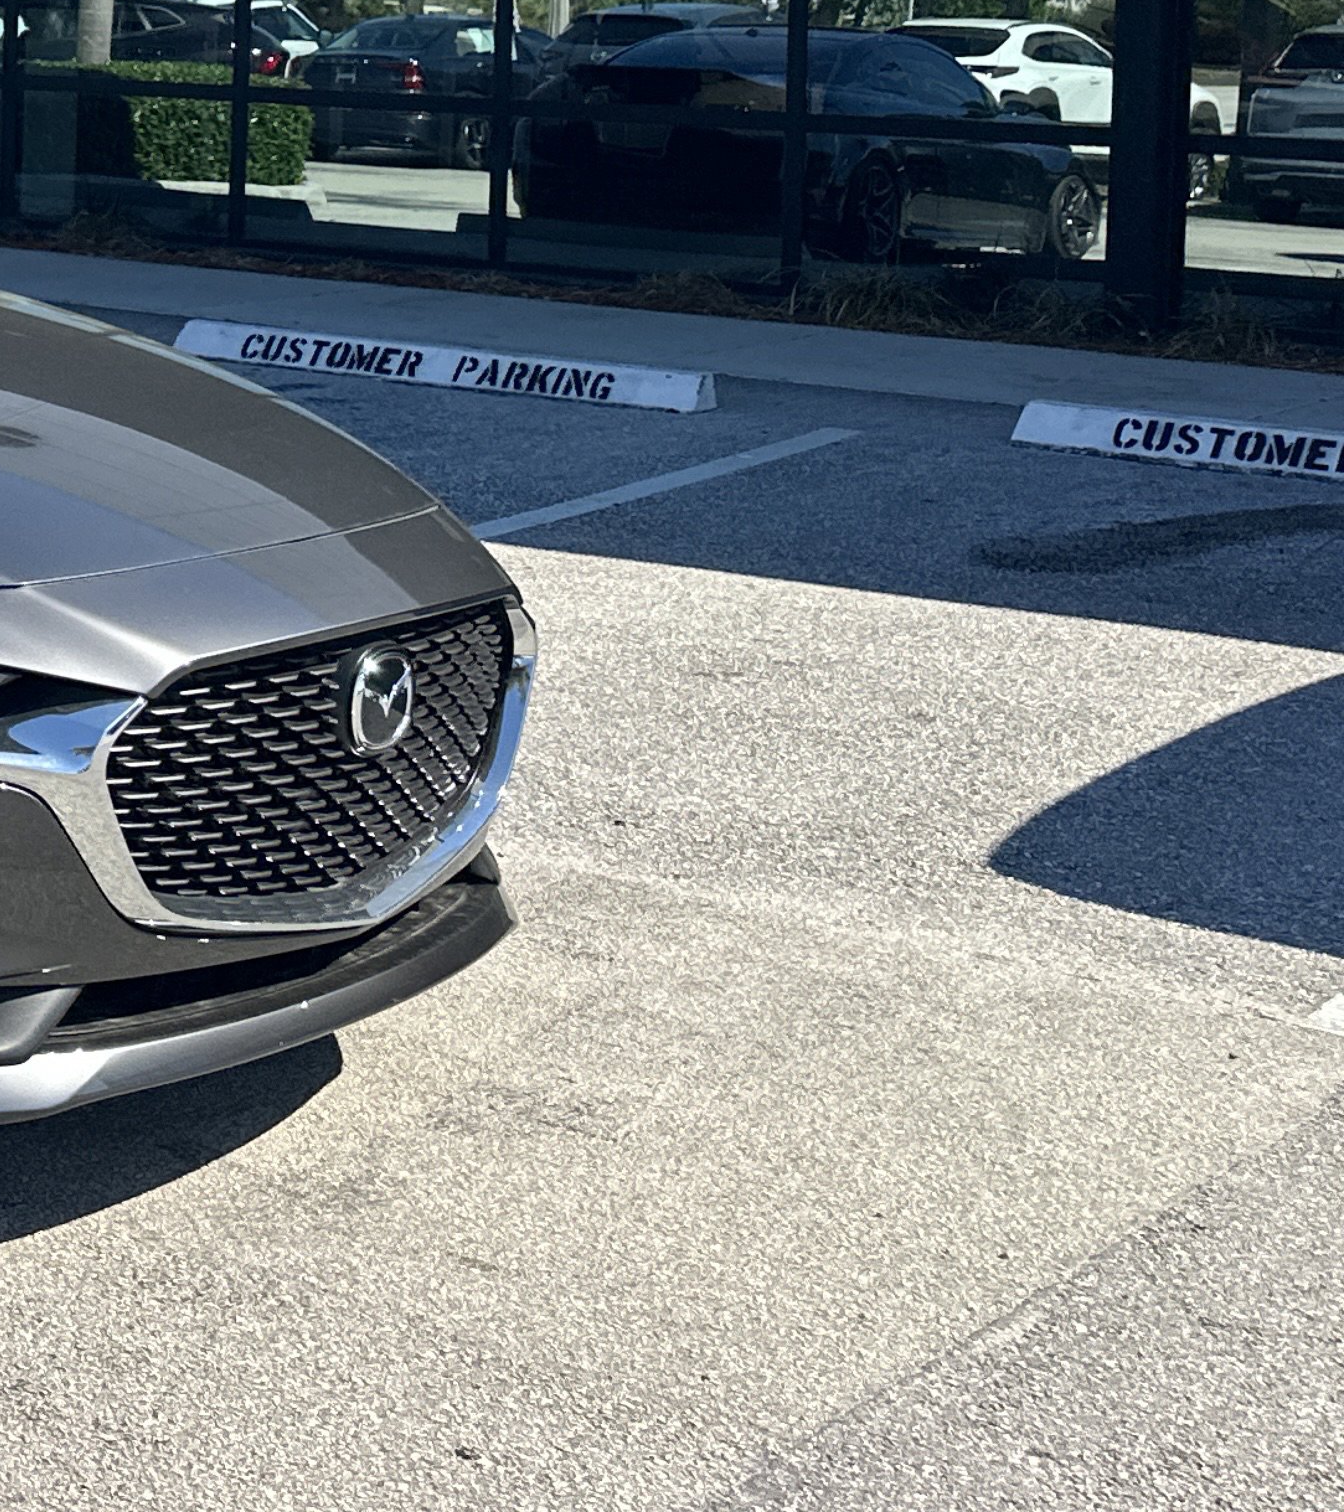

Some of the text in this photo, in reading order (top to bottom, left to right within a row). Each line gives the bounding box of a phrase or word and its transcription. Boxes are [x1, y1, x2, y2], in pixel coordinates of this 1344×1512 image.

[240, 332, 617, 401] CUSTOMER PARKING
[1111, 416, 1344, 473] CUSTOME
